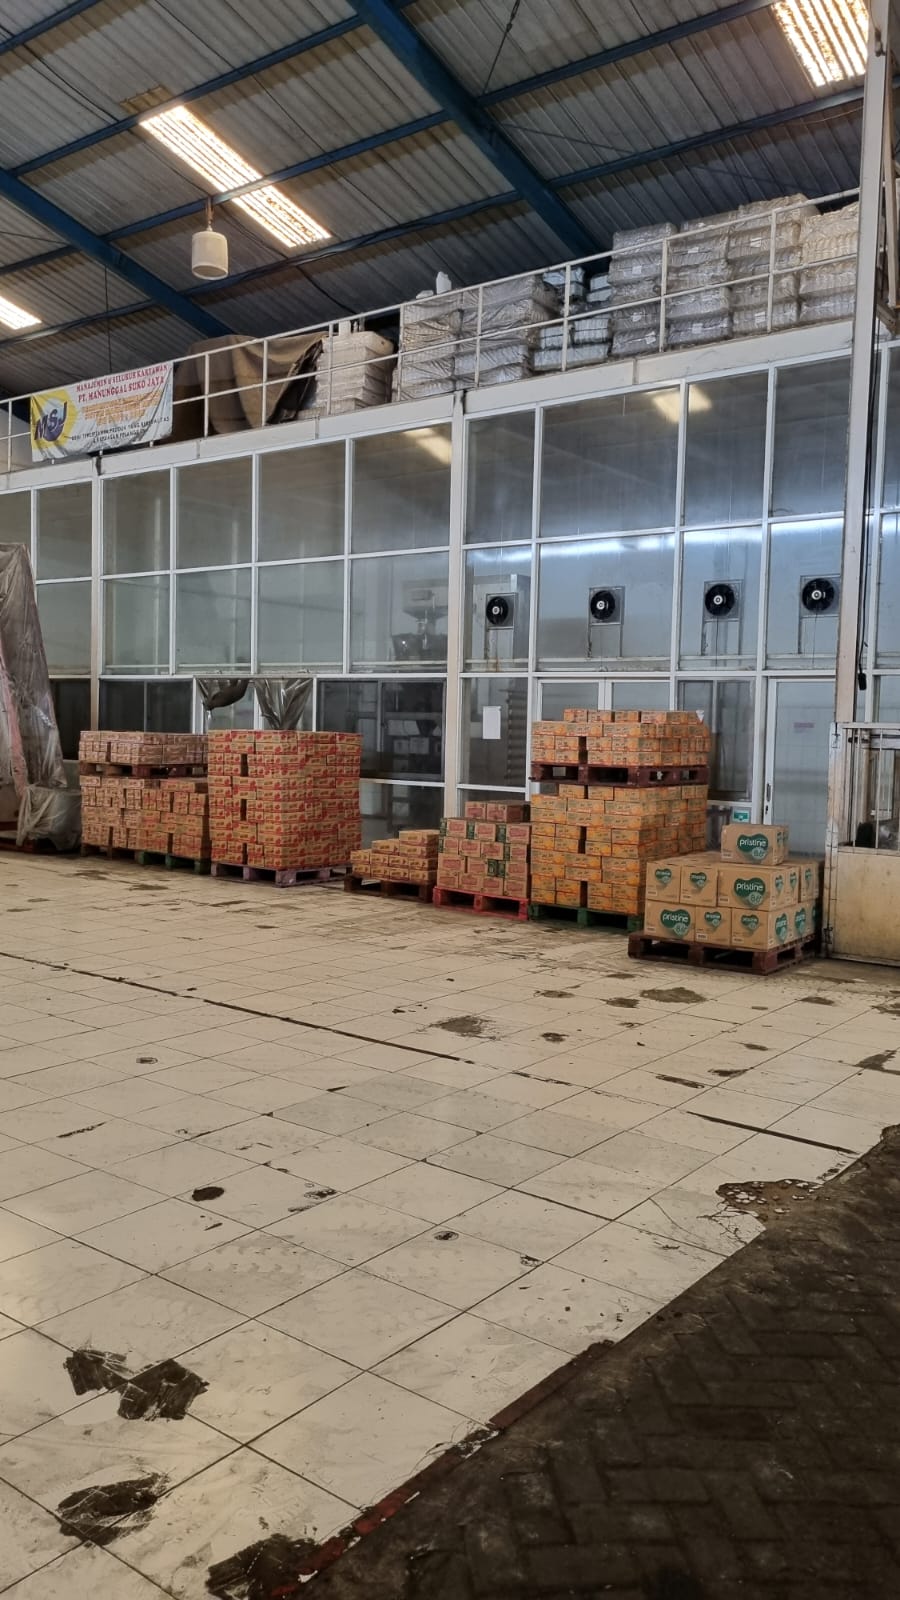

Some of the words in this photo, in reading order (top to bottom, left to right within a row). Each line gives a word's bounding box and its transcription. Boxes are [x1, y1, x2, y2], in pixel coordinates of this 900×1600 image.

[88, 384, 128, 400] MANUNGGAL
[128, 379, 146, 392] SUKO
[147, 375, 164, 387] JAYA
[739, 838, 767, 847] pristine
[736, 882, 764, 892] pristine
[662, 913, 689, 923] pristine
